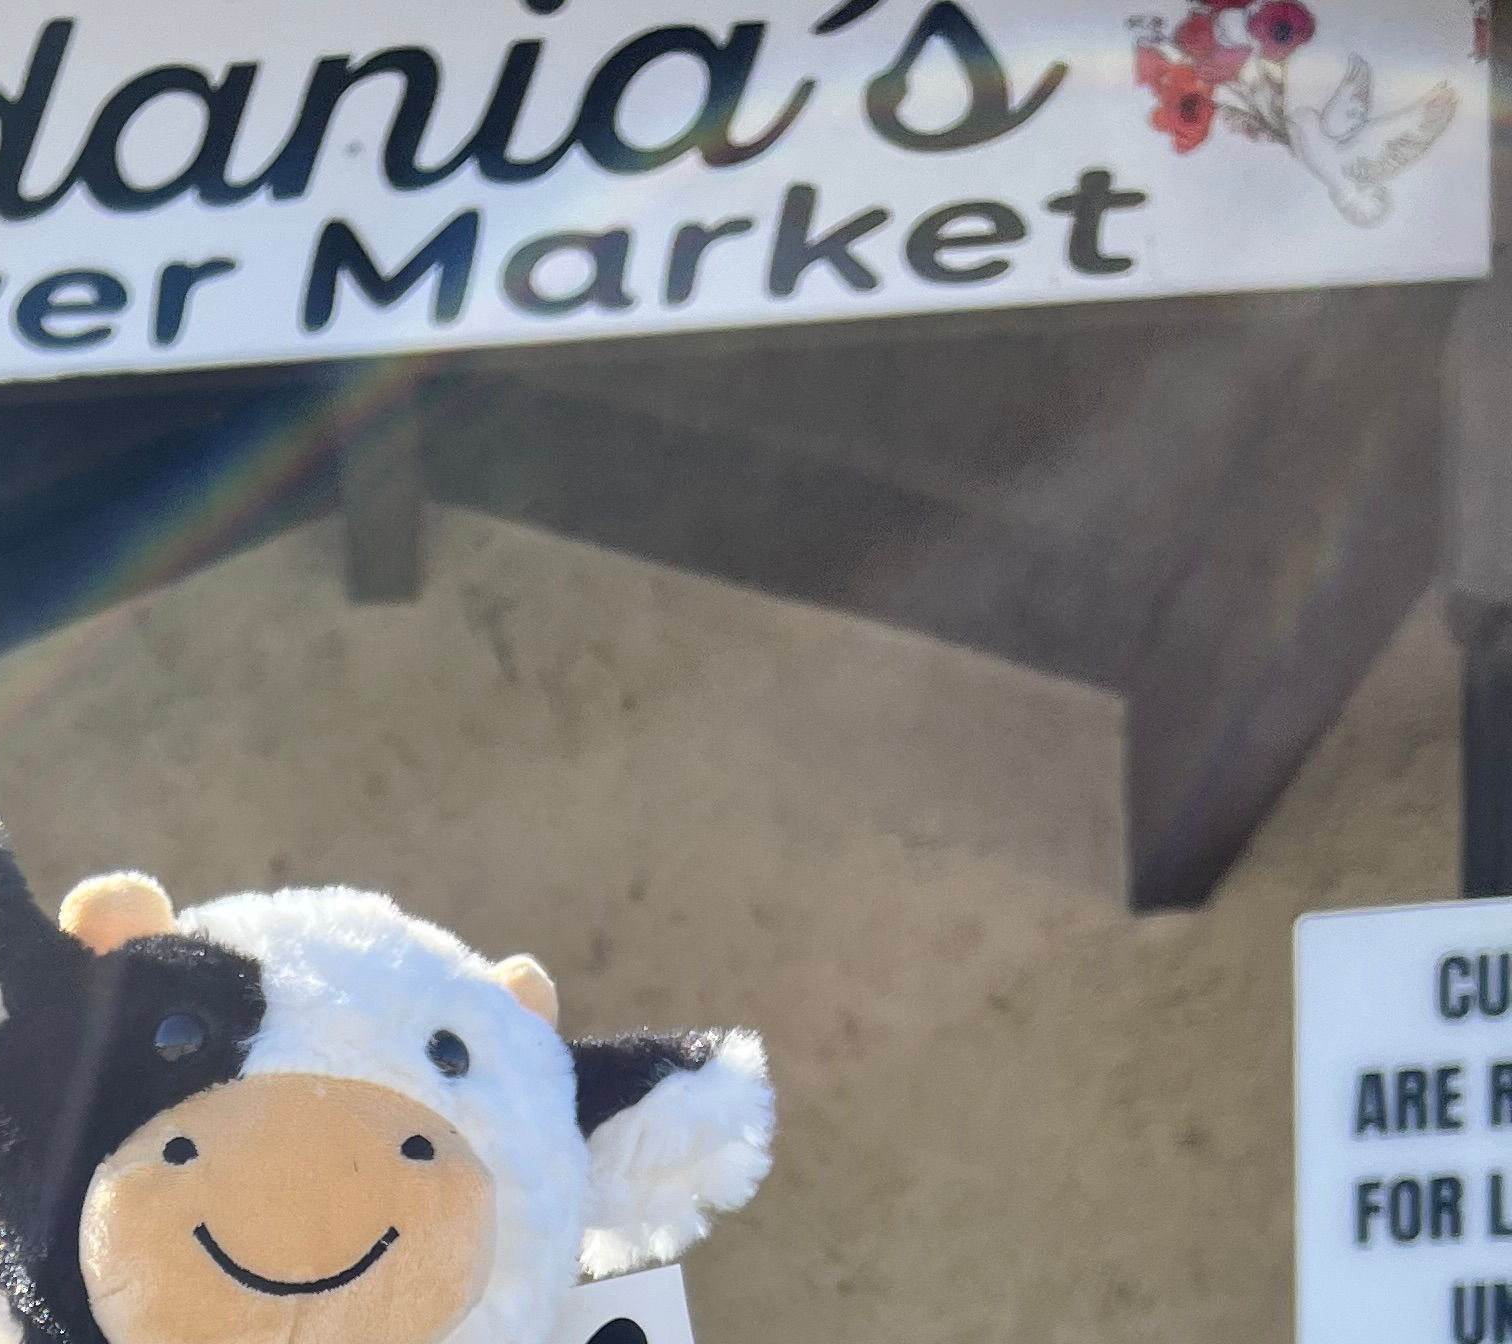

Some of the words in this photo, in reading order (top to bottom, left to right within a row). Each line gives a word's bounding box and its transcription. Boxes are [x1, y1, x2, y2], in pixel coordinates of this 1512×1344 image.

[299, 168, 1149, 332] Market
[1354, 1064, 1465, 1136] ARE
[1355, 1174, 1464, 1244] FOR
